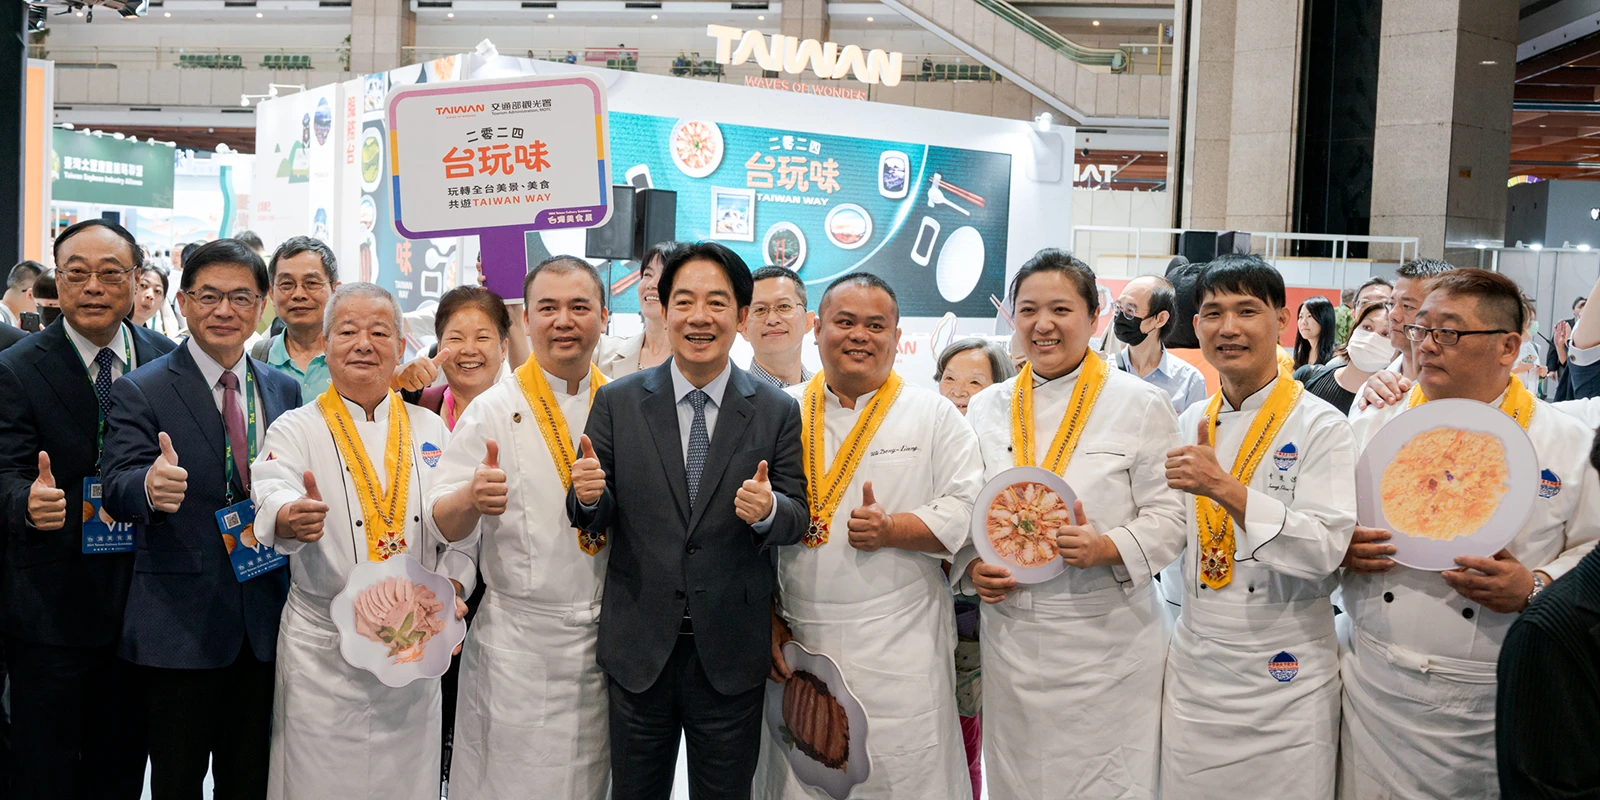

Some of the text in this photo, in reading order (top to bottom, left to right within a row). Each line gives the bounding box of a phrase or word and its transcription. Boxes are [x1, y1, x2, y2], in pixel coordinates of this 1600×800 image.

[707, 24, 903, 87] TAIWAN
[746, 76, 867, 100] WAVES OF WONDER
[435, 104, 485, 115] TAIWAN
[466, 127, 524, 143] 二零二四
[769, 135, 821, 155] 二零二四
[442, 139, 551, 179] 台玩味
[64, 171, 83, 180] Taiwan
[745, 151, 841, 194] 台玩味
[448, 180, 550, 196] 玩轉全台美景、美食
[525, 193, 552, 202] WAY
[756, 193, 829, 206] TAIWAN WAY
[395, 240, 413, 276] 味
[394, 280, 413, 290] TAIWAN
[106, 521, 133, 532] VIP
